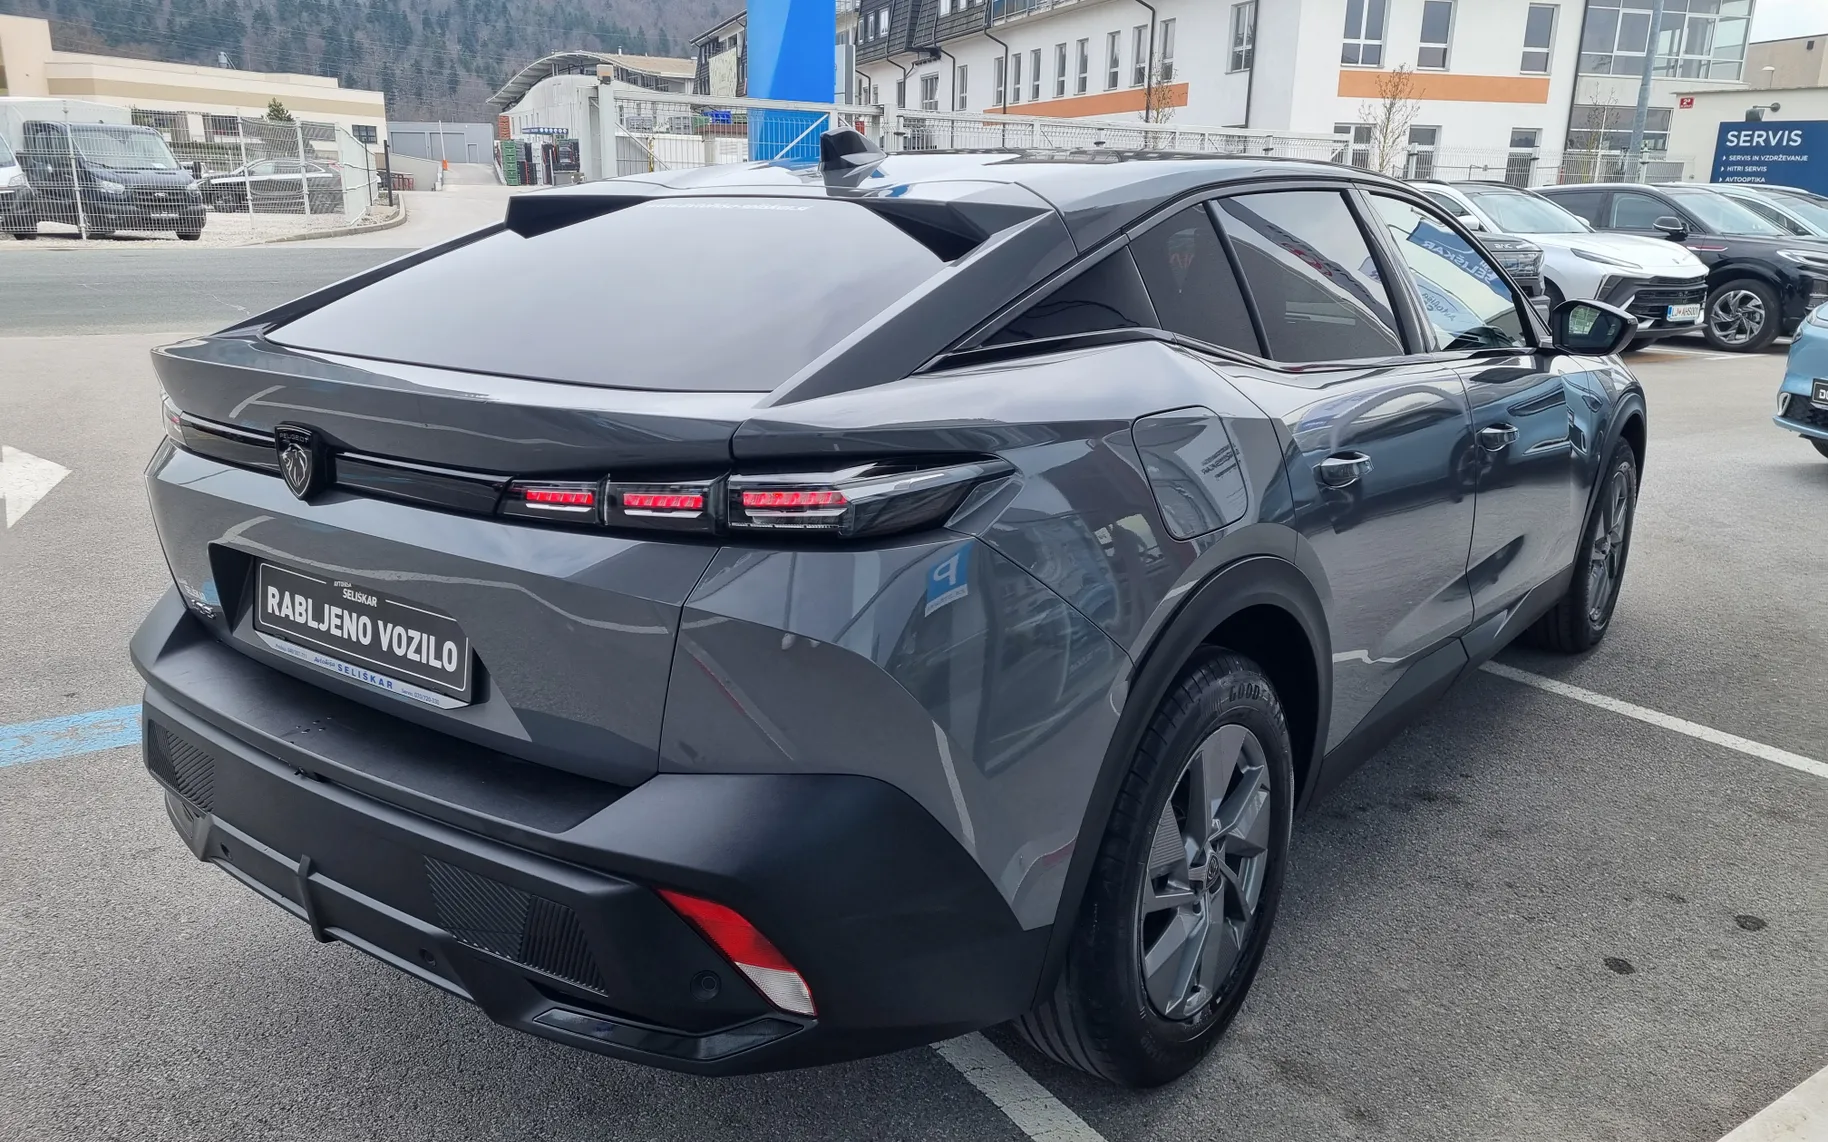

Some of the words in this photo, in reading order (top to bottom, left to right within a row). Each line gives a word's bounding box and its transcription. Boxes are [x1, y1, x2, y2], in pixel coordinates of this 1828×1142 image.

[1726, 130, 1803, 147] SERVIS
[1760, 154, 1809, 162] VZDRŽEVANJE
[279, 432, 309, 443] PEUGEOT
[342, 588, 378, 608] SELIŠKAR
[267, 585, 372, 646] RABLJENO
[377, 619, 458, 672] VOZILO
[337, 663, 394, 690] SELIŠKAR
